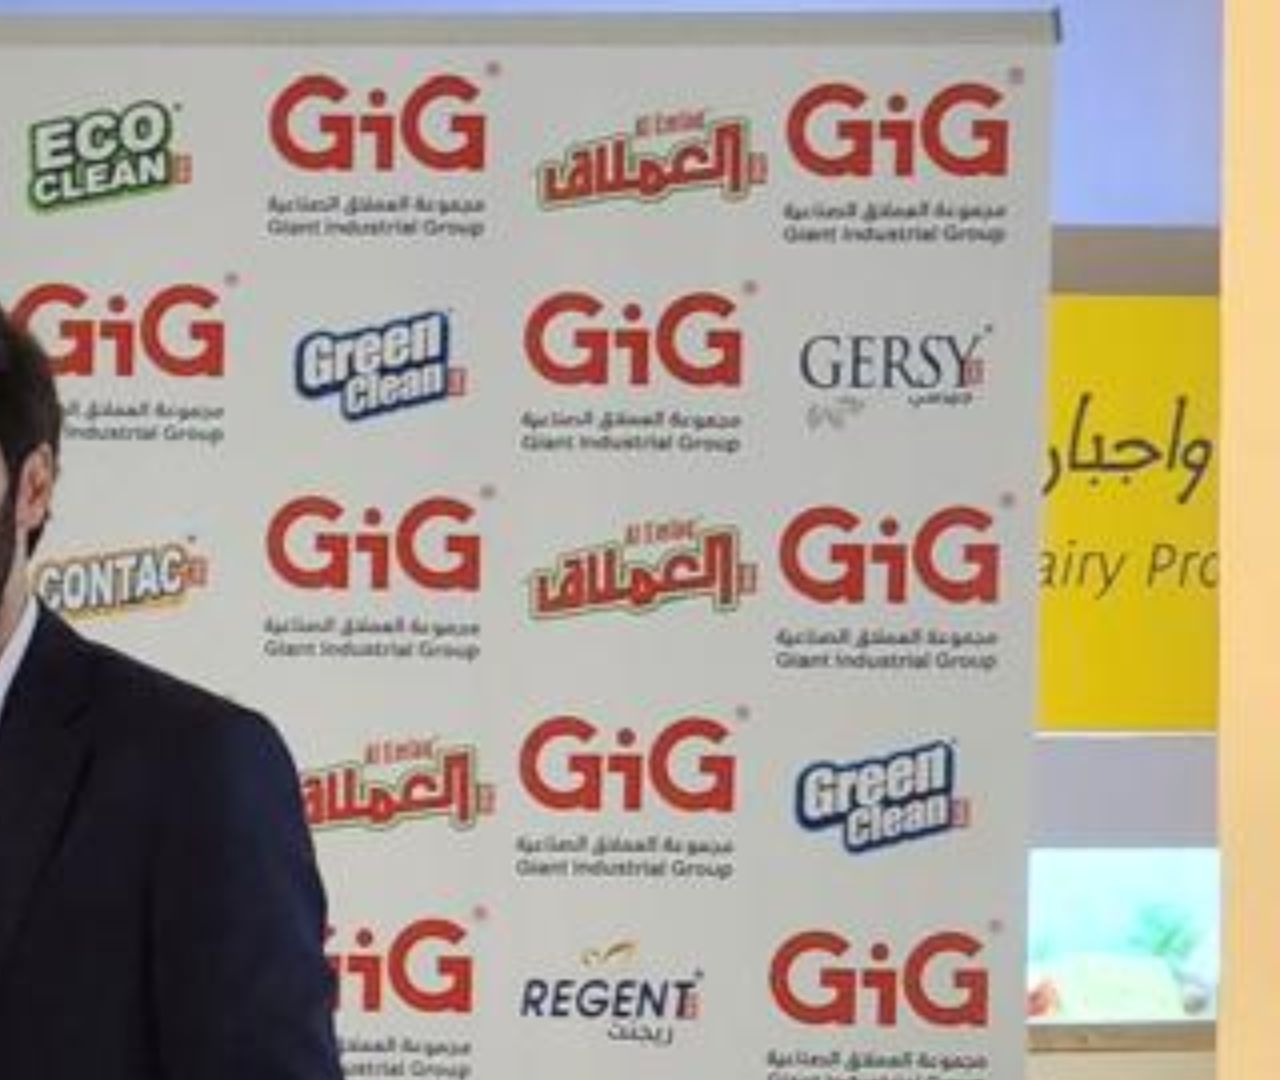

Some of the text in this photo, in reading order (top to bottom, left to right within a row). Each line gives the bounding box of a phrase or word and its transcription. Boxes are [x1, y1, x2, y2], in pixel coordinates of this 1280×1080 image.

[35, 103, 169, 171] ECO
[269, 73, 487, 172] GiG
[785, 82, 1009, 179] GiG
[34, 152, 167, 203] CLEAN
[268, 220, 484, 238] Giant Industrial Group
[783, 224, 1005, 244] Giant Industrial Group
[11, 283, 227, 377] GiG
[302, 315, 443, 388] Green
[523, 293, 745, 386] GiG
[347, 364, 443, 414] Clean
[799, 334, 982, 389] GERSY
[164, 425, 224, 443] Group
[521, 434, 740, 453] Giant Industrial Group
[267, 496, 482, 592] GiG
[778, 506, 1000, 603] GiG
[1039, 541, 1218, 599] airy Pro
[39, 547, 184, 609] CONTAC
[264, 641, 480, 661] Giant Industrial Group
[776, 651, 996, 671] Giant Industrial Group
[519, 716, 736, 813] GiG
[803, 744, 947, 820] Green
[847, 796, 947, 848] Clean
[516, 860, 733, 880] Giant Industrial Group
[520, 977, 696, 1020] REGENT
[769, 930, 989, 1029] GiG
[410, 1059, 471, 1080] Group
